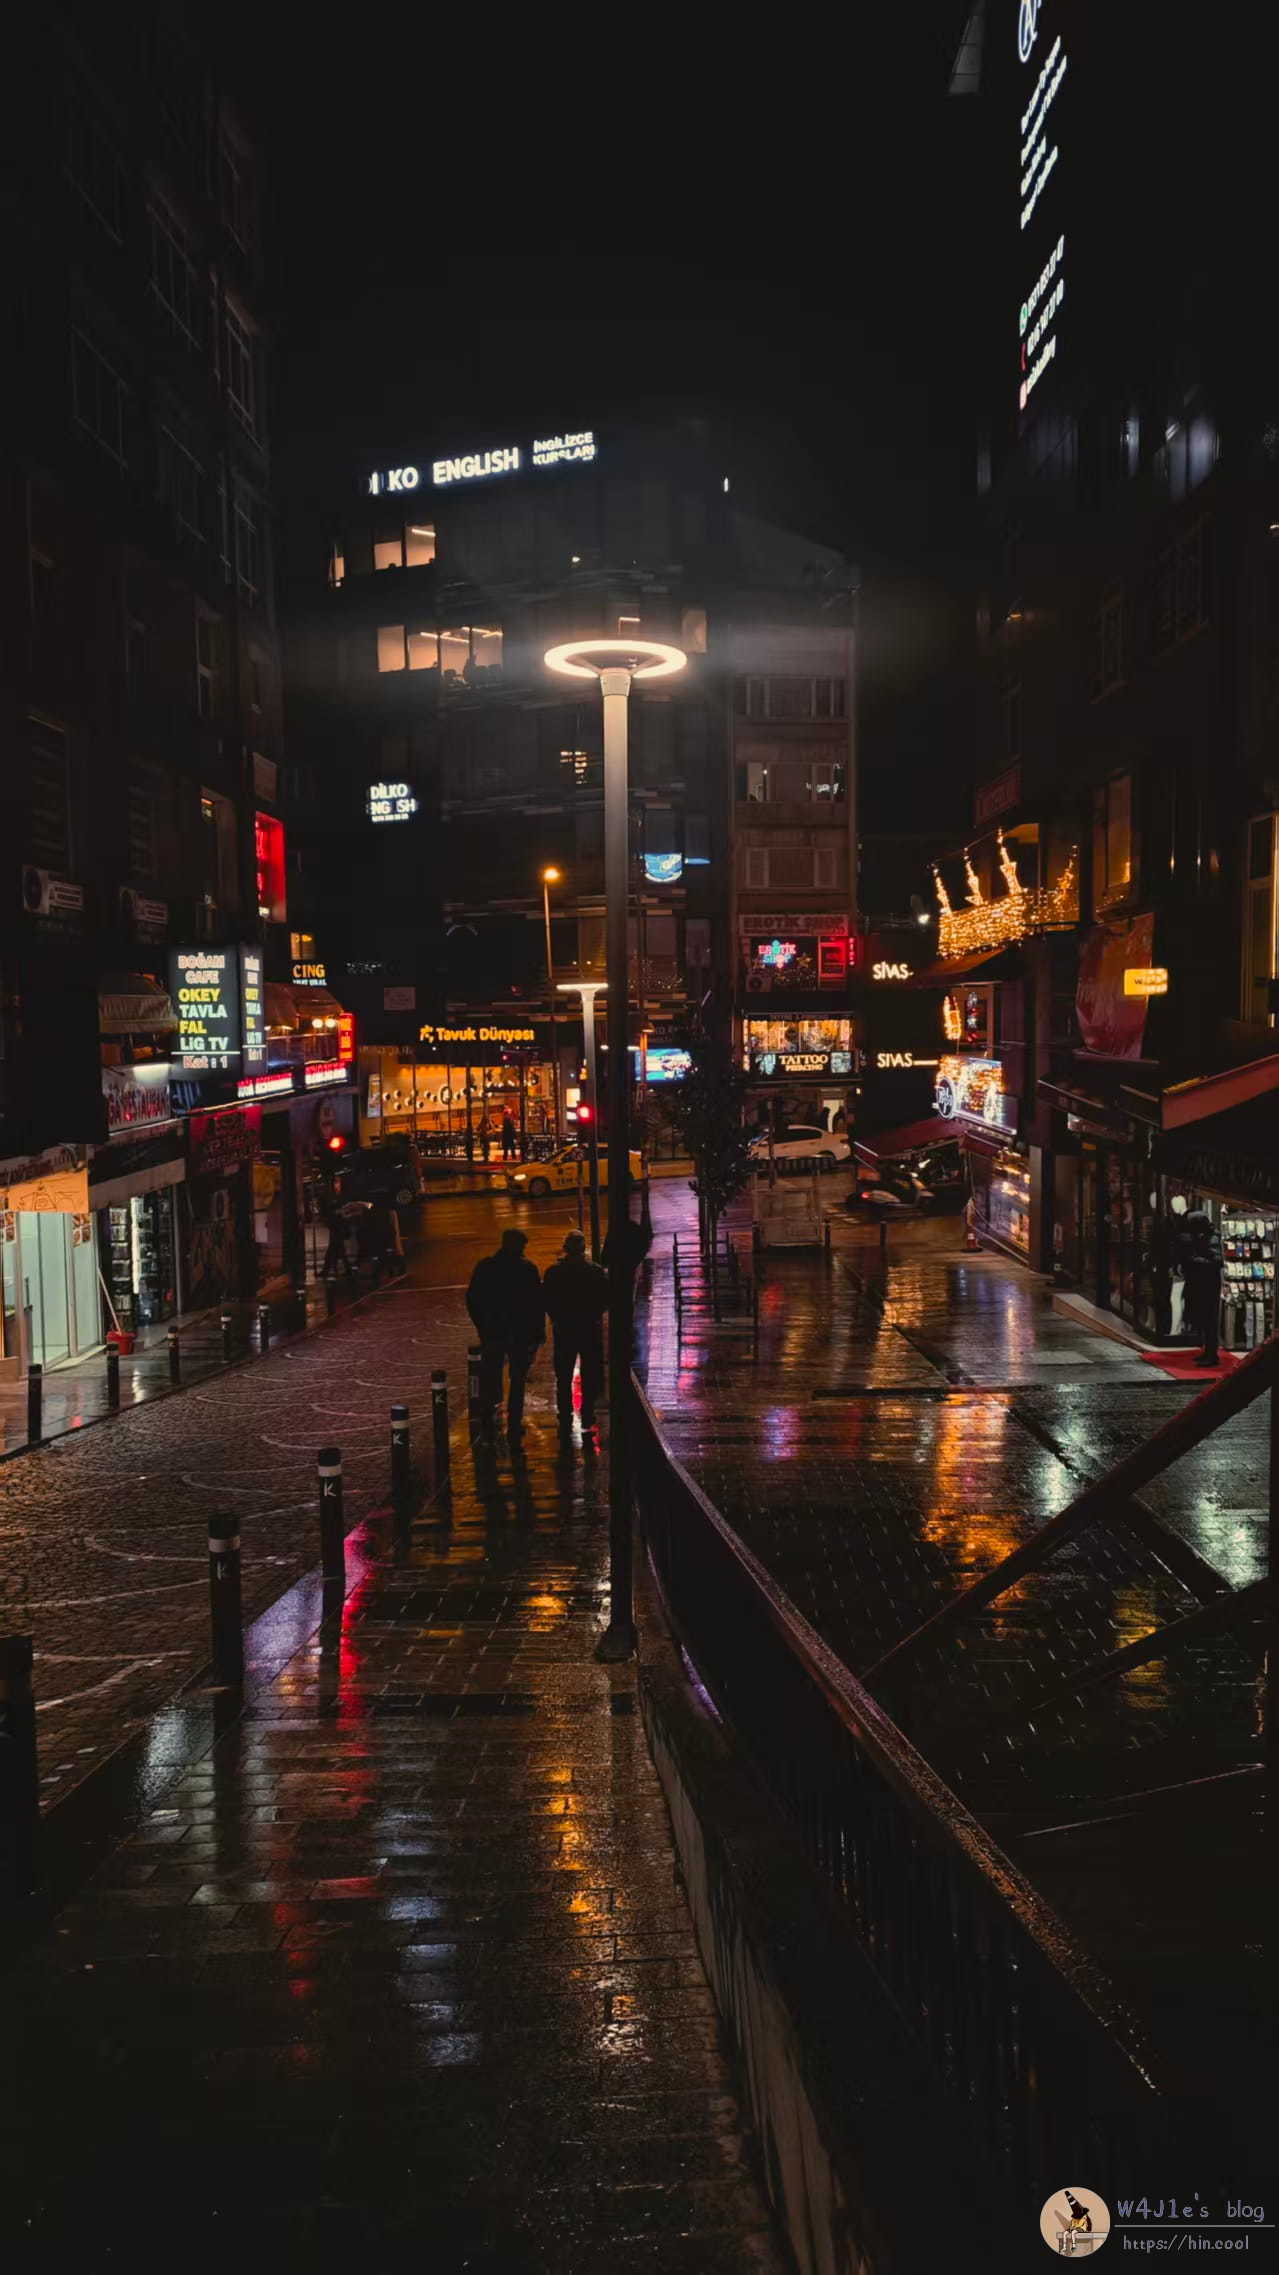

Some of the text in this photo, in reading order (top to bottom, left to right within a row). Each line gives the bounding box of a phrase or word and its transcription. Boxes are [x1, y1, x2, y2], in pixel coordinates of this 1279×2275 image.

[432, 447, 520, 485] ENGLISH
[369, 781, 409, 800] DİLKO
[185, 970, 220, 984] CAFE
[292, 963, 326, 979] CING
[178, 988, 221, 1002] OKEY
[178, 1004, 228, 1018] TAVLA
[179, 1020, 207, 1034] FAL
[436, 1026, 535, 1044] Tavuk Dünyası
[208, 1037, 229, 1051] TV
[778, 1054, 829, 1065] TATTOO
